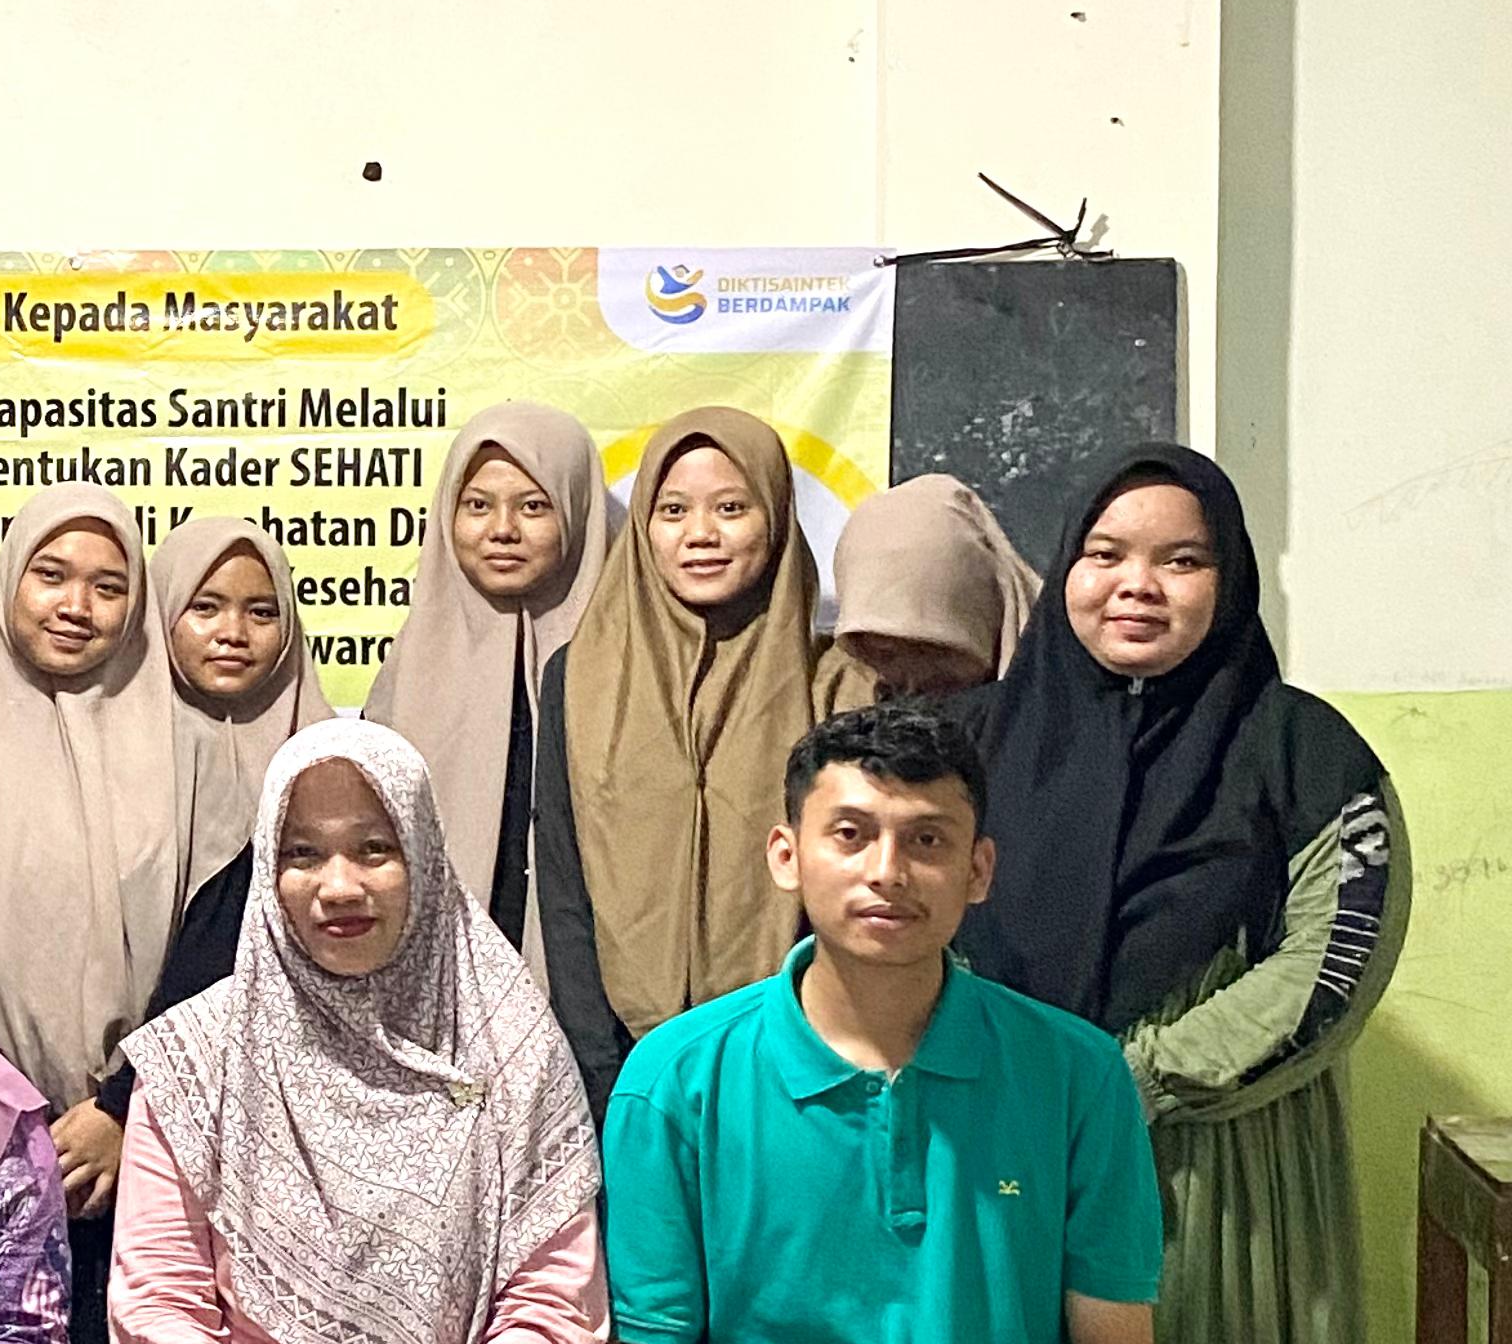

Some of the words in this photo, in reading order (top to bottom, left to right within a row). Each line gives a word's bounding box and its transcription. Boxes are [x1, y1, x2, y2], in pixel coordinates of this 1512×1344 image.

[717, 276, 851, 294] DIKTISAINTEK
[717, 296, 852, 314] BERDAMPAK
[5, 291, 151, 344] Kepada
[164, 290, 399, 343] Masyarakat
[167, 388, 287, 428] Santri
[299, 387, 447, 428] Melalui
[165, 446, 280, 487] Kader
[290, 447, 423, 488] SEHATI
